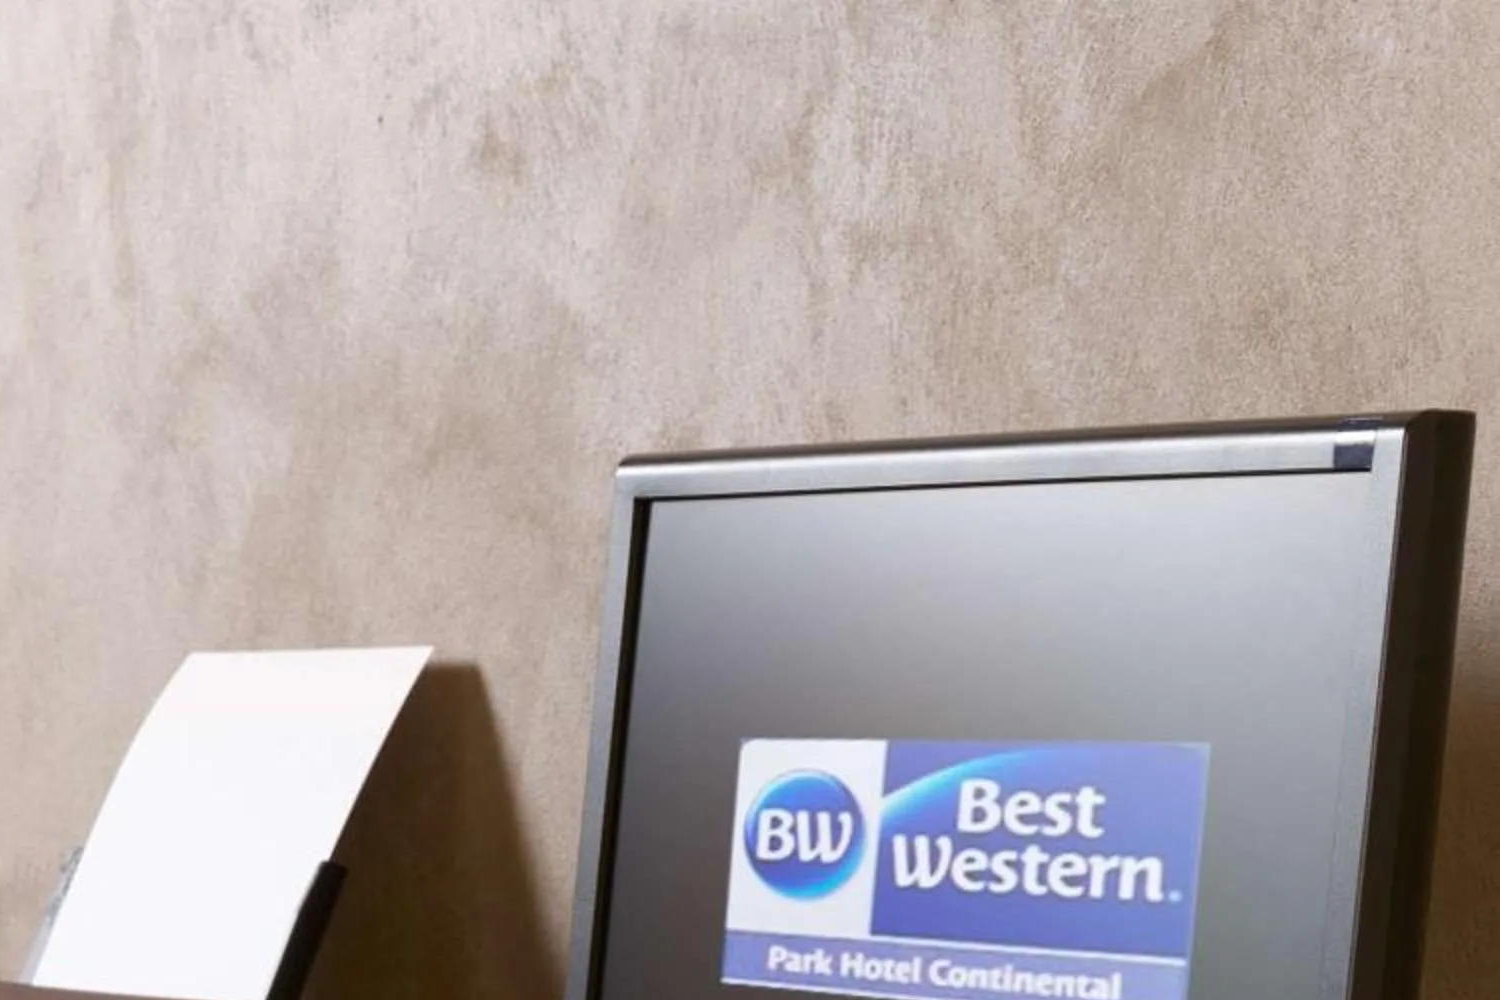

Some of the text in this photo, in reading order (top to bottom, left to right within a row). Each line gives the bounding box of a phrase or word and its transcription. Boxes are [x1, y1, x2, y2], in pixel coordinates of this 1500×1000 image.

[755, 808, 854, 864] BW
[956, 778, 1107, 839] Best
[767, 945, 1122, 1000] Park Hotel Continental
